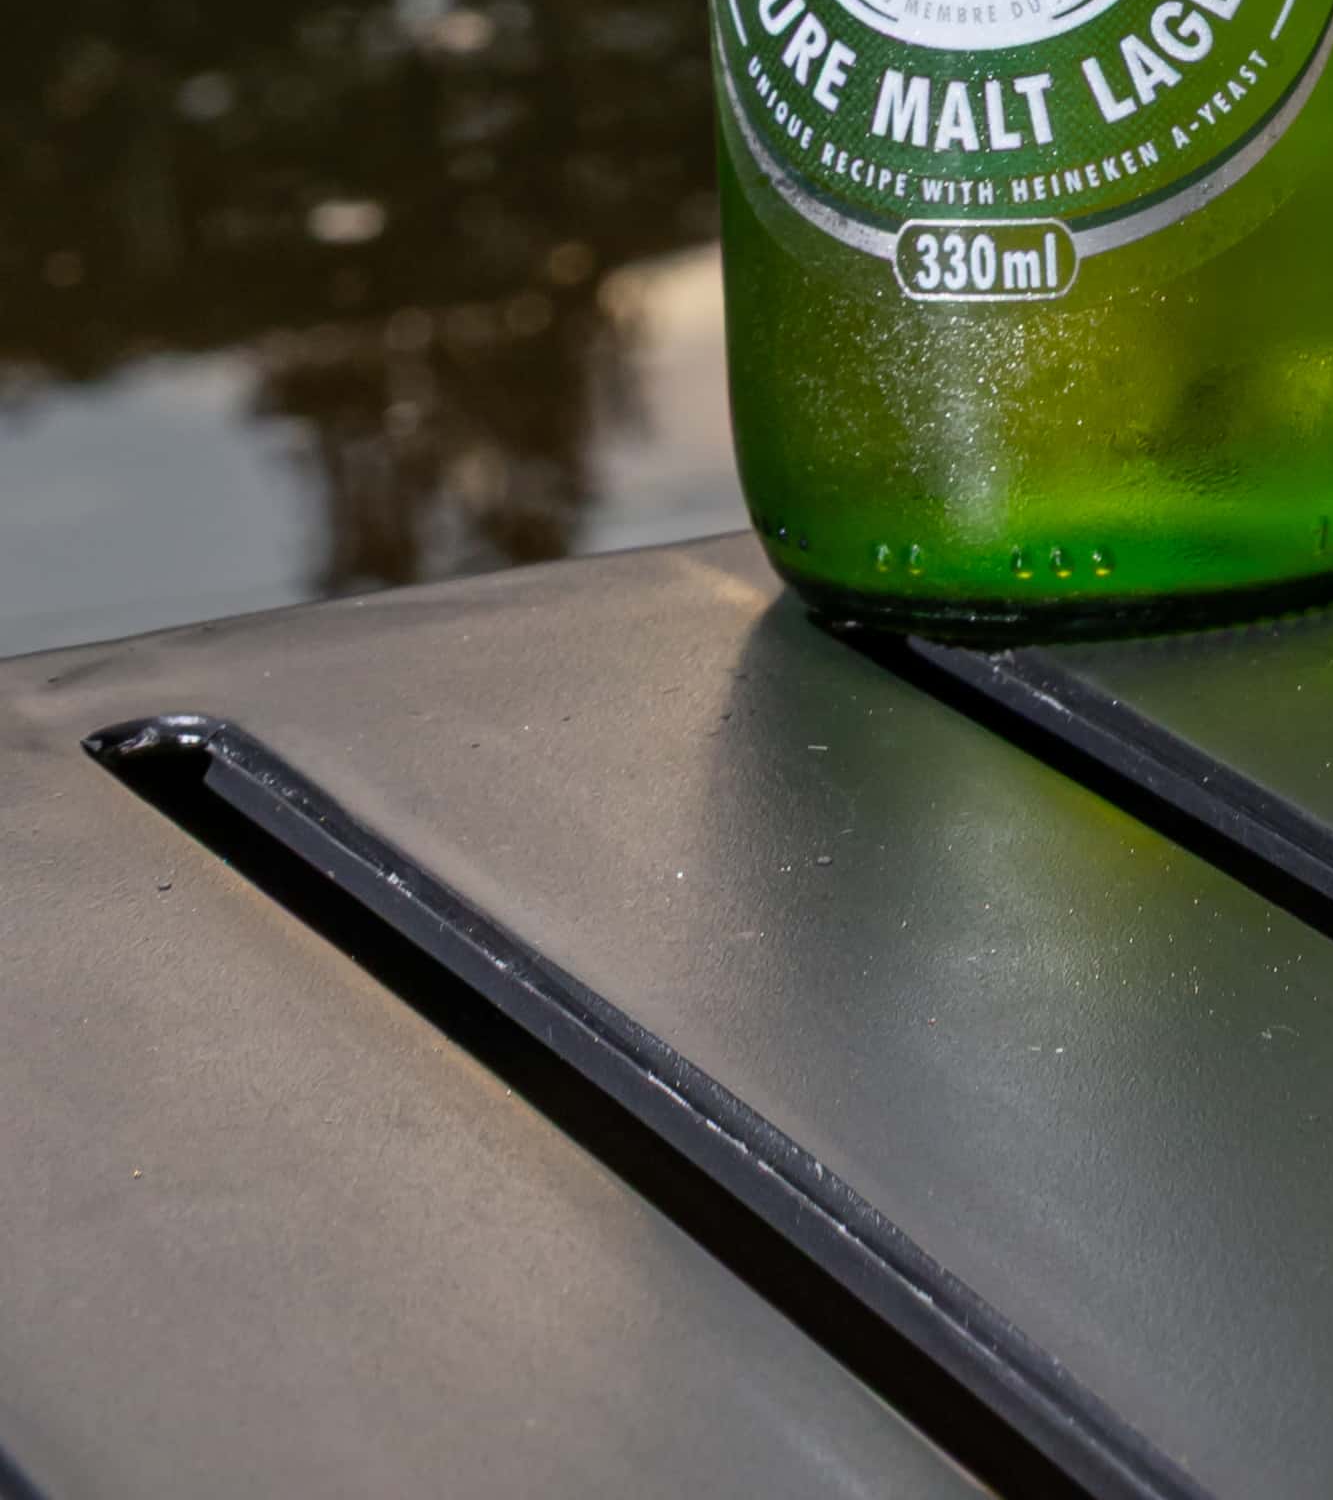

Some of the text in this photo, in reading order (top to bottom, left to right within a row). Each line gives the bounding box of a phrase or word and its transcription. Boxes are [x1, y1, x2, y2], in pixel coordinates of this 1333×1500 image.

[747, 49, 1269, 205] UNIQUE RECIPE WITH HEINEKEN A-YEAST
[871, 67, 1054, 152] MALT
[915, 231, 1058, 292] 330ml
